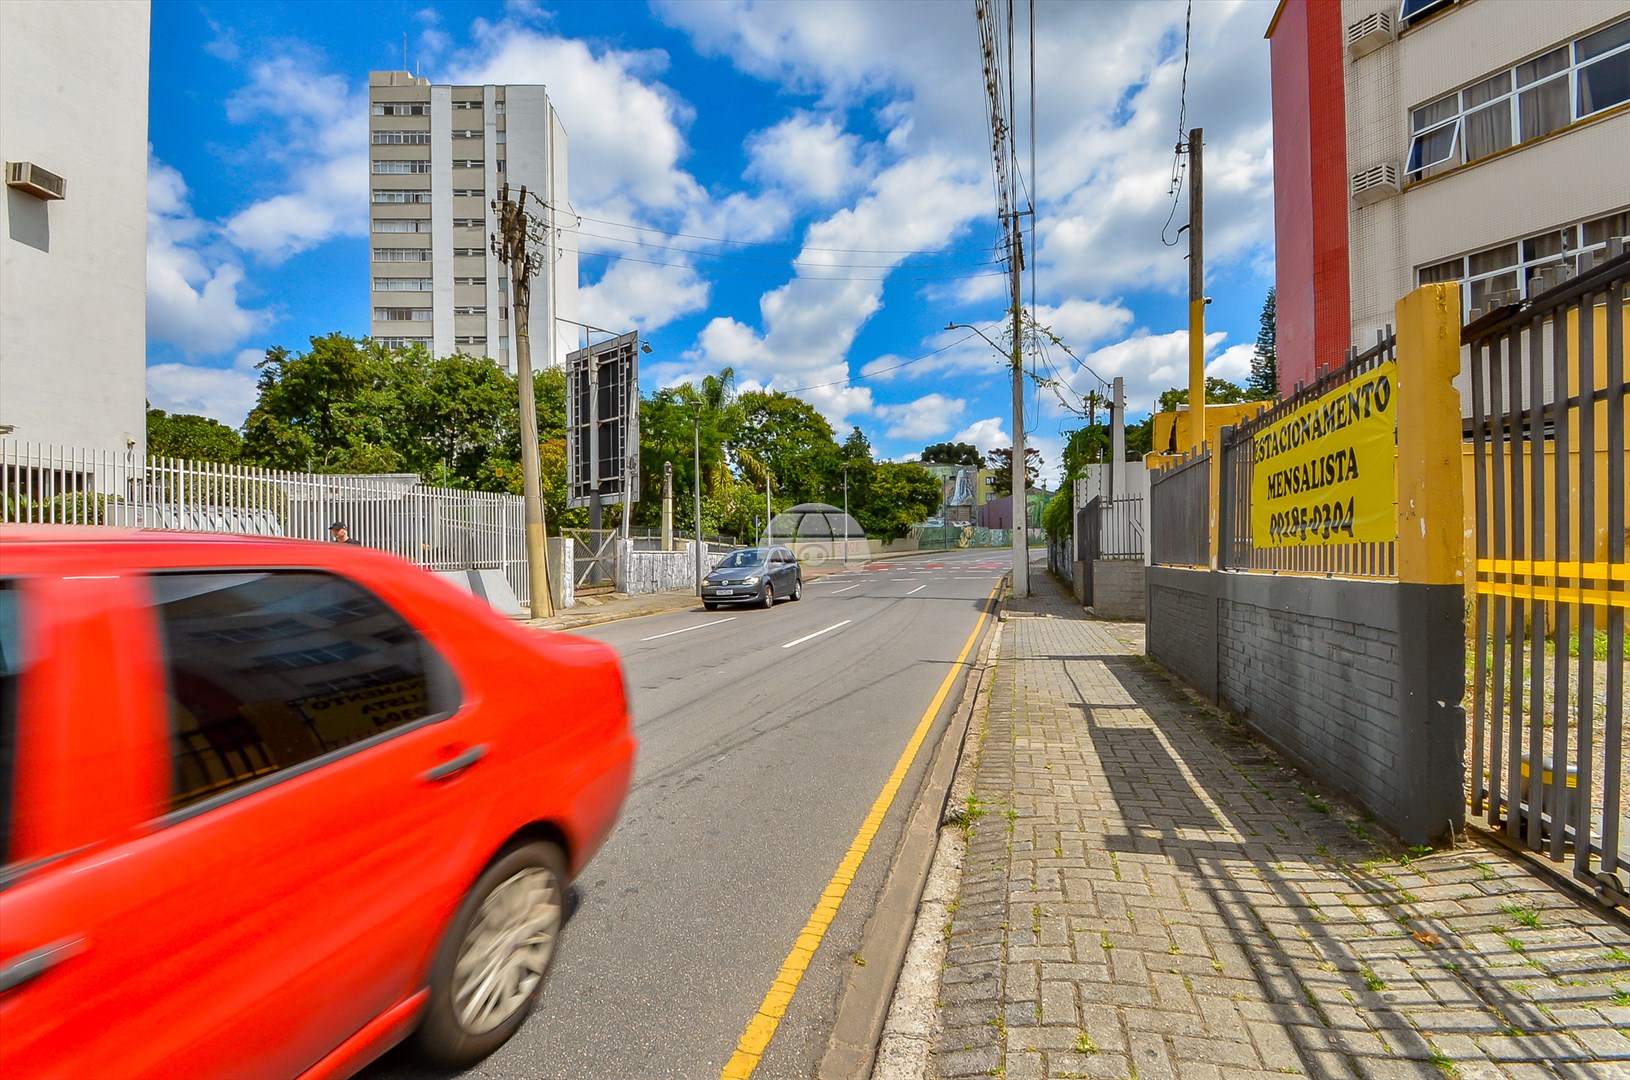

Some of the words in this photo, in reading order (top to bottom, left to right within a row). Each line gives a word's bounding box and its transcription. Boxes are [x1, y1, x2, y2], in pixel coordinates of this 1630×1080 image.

[1254, 375, 1390, 464] ESTACIONAMENTO
[1267, 446, 1359, 500] MENSALISTA
[1269, 496, 1354, 544] 99185-0304
